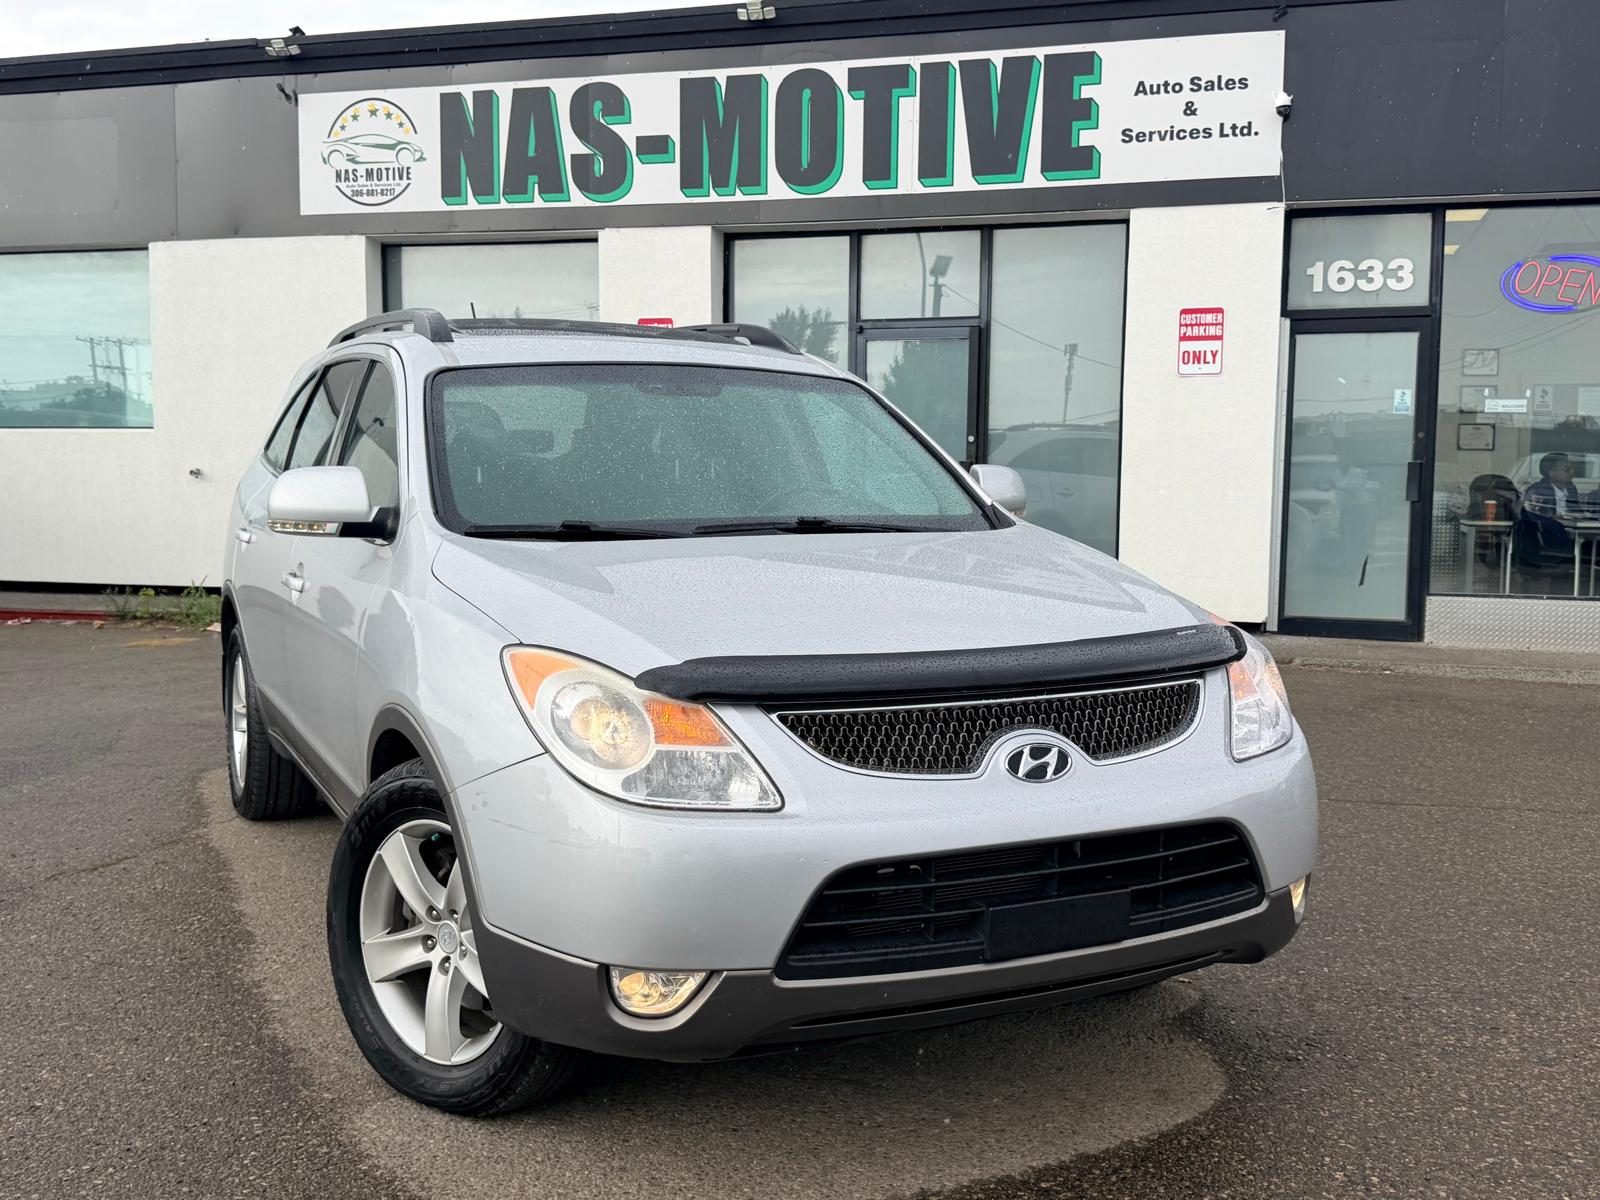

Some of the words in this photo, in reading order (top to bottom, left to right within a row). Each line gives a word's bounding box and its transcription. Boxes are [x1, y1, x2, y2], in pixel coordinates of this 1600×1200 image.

[1133, 80, 1184, 96] Auto
[1189, 75, 1249, 93] Sales
[1183, 100, 1198, 117] &
[439, 51, 1101, 205] NAS-MOTIVE
[1120, 125, 1213, 144] Services
[1219, 121, 1260, 138] Ltd.
[335, 166, 412, 183] NAS-MOTIVE
[1306, 258, 1415, 293] 1633
[1515, 261, 1600, 305] OPEN
[1180, 313, 1223, 325] CUSTOMER
[1180, 325, 1223, 337] PARKING
[1182, 350, 1219, 365] ONLY
